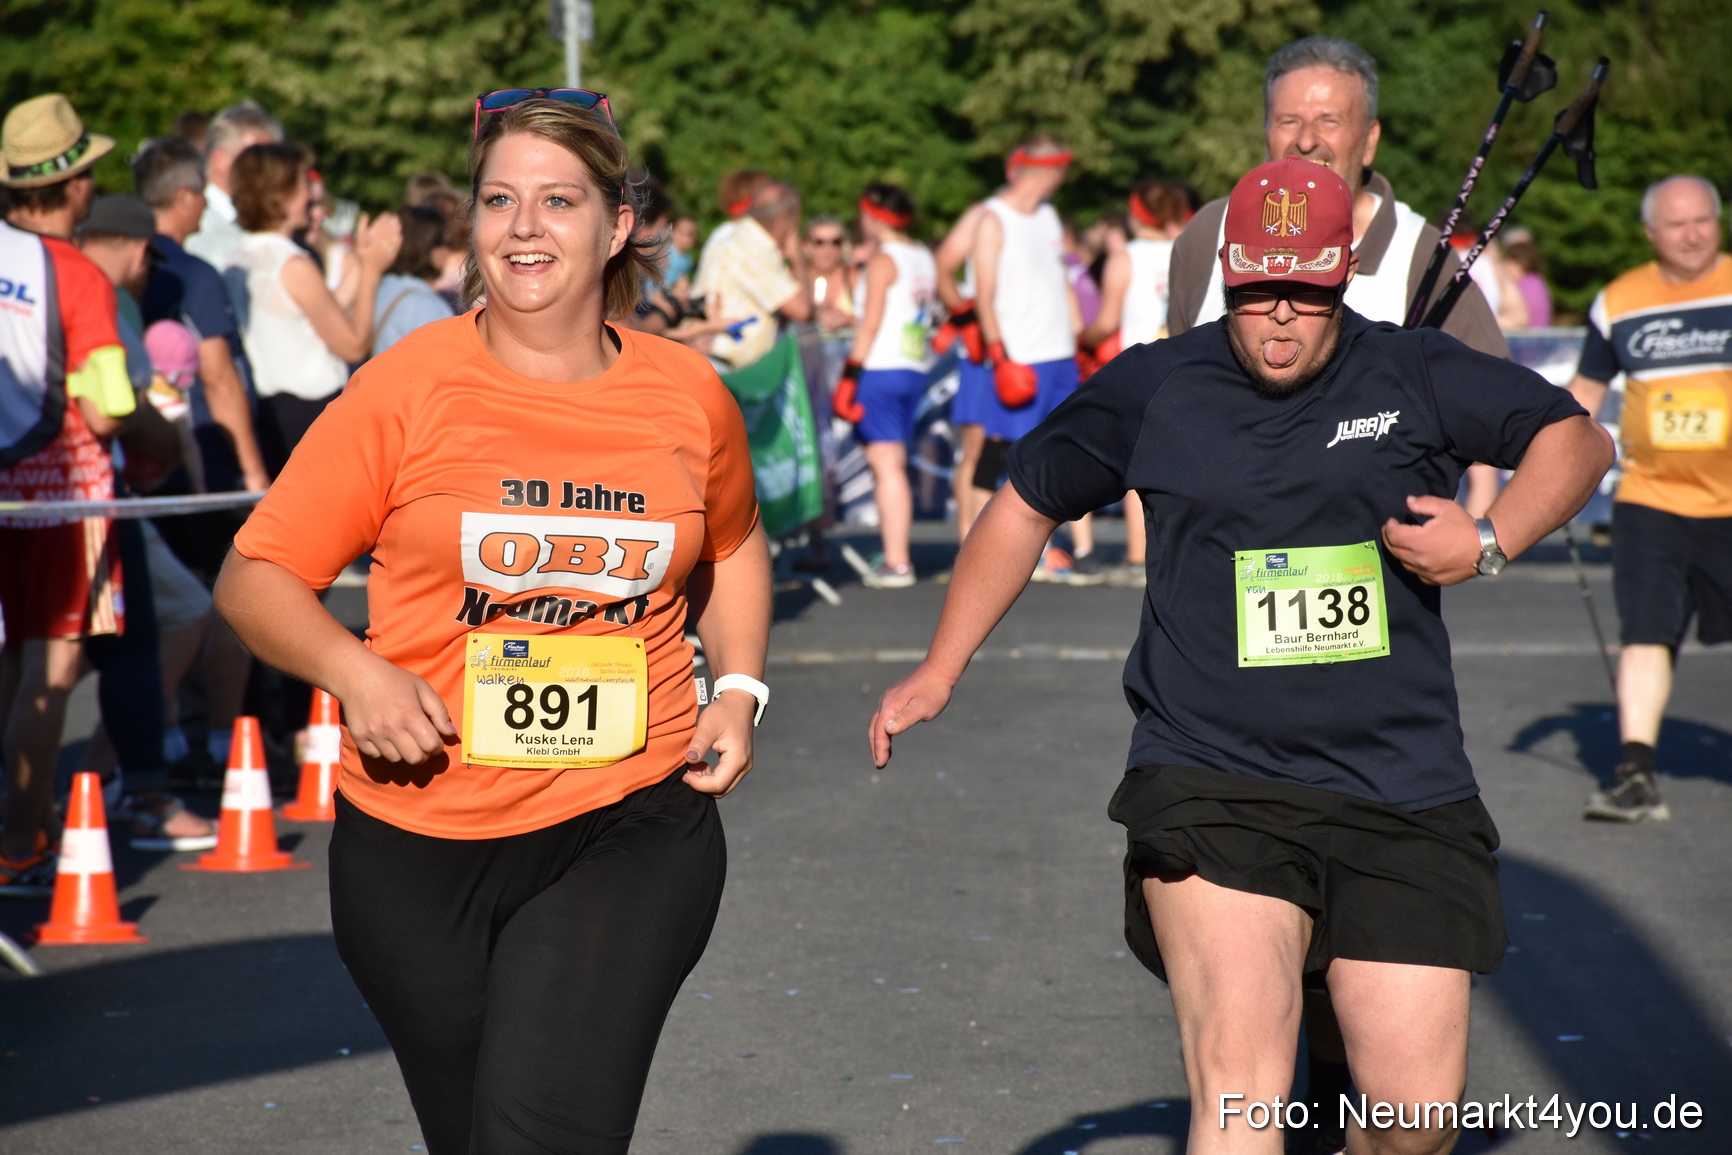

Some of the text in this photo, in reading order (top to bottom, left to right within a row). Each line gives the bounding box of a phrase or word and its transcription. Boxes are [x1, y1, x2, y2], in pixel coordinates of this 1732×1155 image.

[1439, 155, 1484, 250] EASY WAY
[1454, 196, 1516, 283] EASY WAY
[1298, 250, 1337, 271] ROTHENBURG
[1663, 410, 1708, 433] 572
[1327, 416, 1379, 449] JURA
[500, 479, 647, 514] 30 Jahre
[479, 531, 660, 581] OBI
[1256, 566, 1309, 578] firmenlauf
[1315, 573, 1344, 584] 2018
[455, 586, 650, 627] Neumakt
[1257, 585, 1370, 632] 1138
[1265, 640, 1366, 654] Lebenshilfe Neumarkt e.V.
[1274, 629, 1359, 644] Baur Bernhard
[490, 656, 553, 668] firmenlauf
[558, 667, 590, 678] 2018
[476, 673, 525, 686] walken
[503, 684, 599, 731] 891
[514, 733, 595, 746] Kuske Lena
[526, 747, 581, 757] Klebl GmbH
